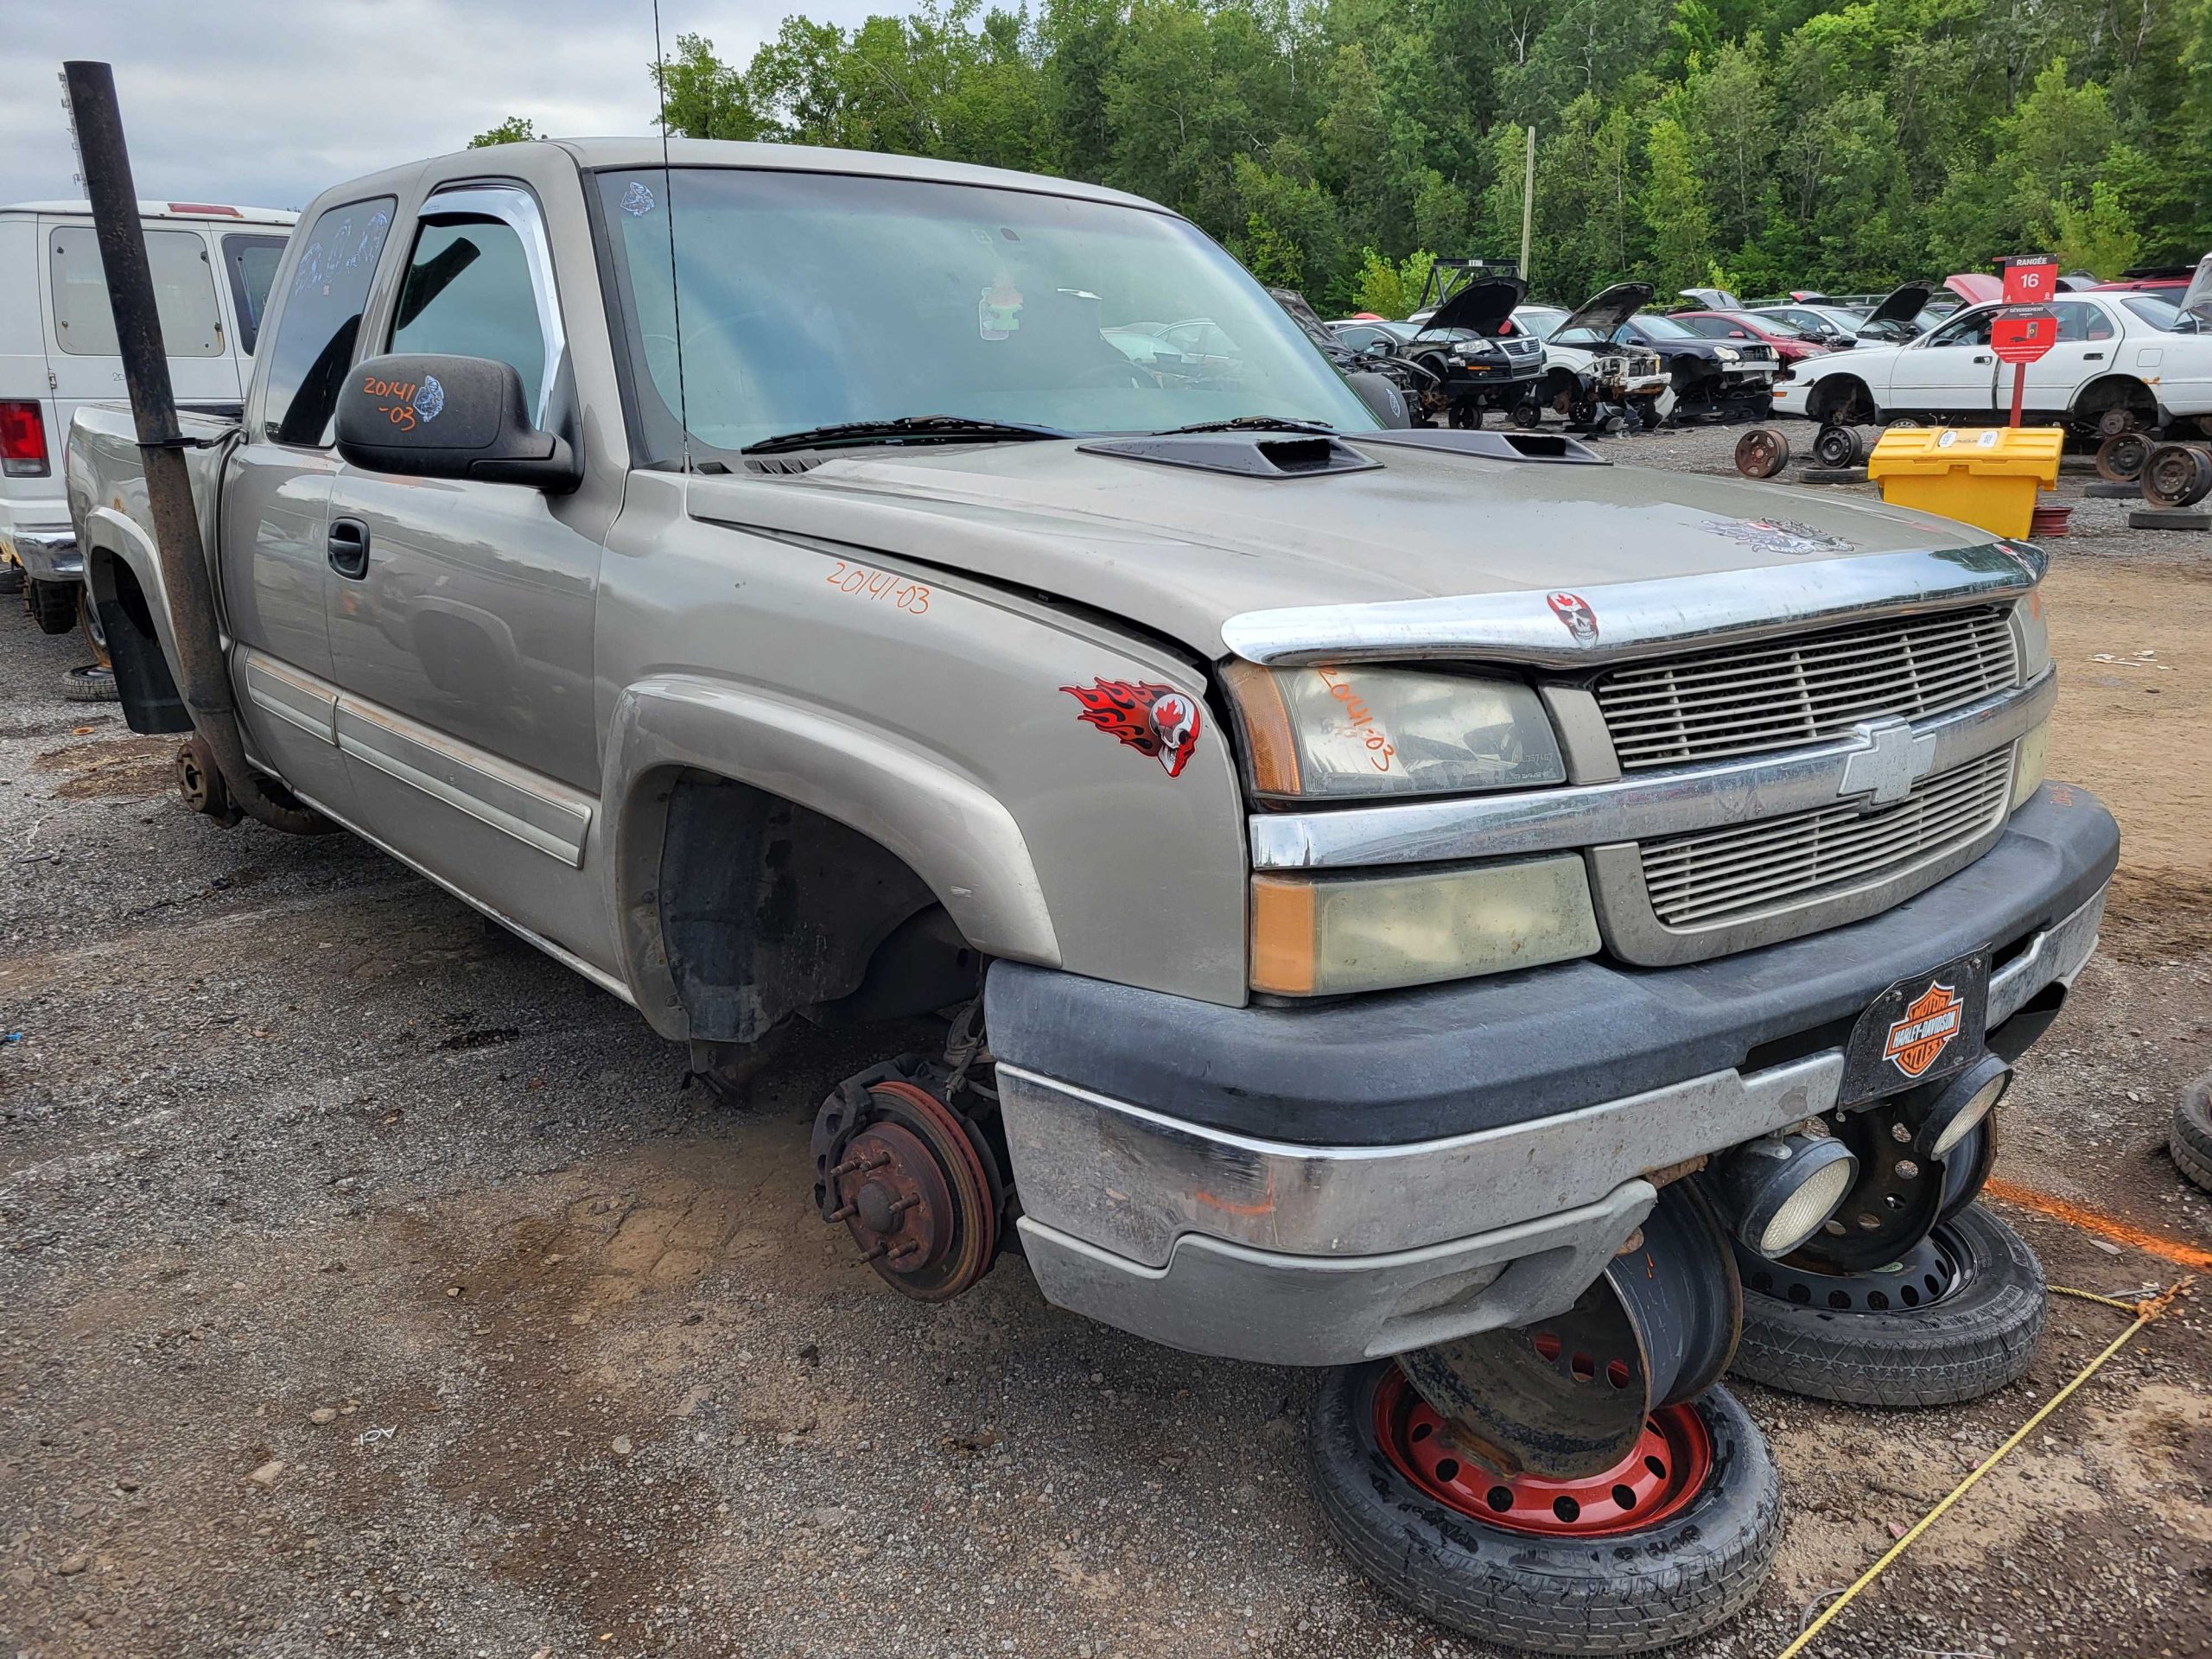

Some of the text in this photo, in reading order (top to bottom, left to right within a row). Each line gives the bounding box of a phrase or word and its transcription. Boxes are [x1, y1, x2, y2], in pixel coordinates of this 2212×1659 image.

[2016, 257, 2048, 266] RANGÉE
[2020, 273, 2040, 289] 16
[363, 377, 416, 402] 20141
[378, 406, 416, 431] -03
[826, 562, 931, 614] 20141-03
[1912, 995, 1948, 1021] MOTOR
[1891, 1009, 1956, 1050] HARLEY-DAVIDSON
[1903, 1039, 1942, 1070] CYCLES
